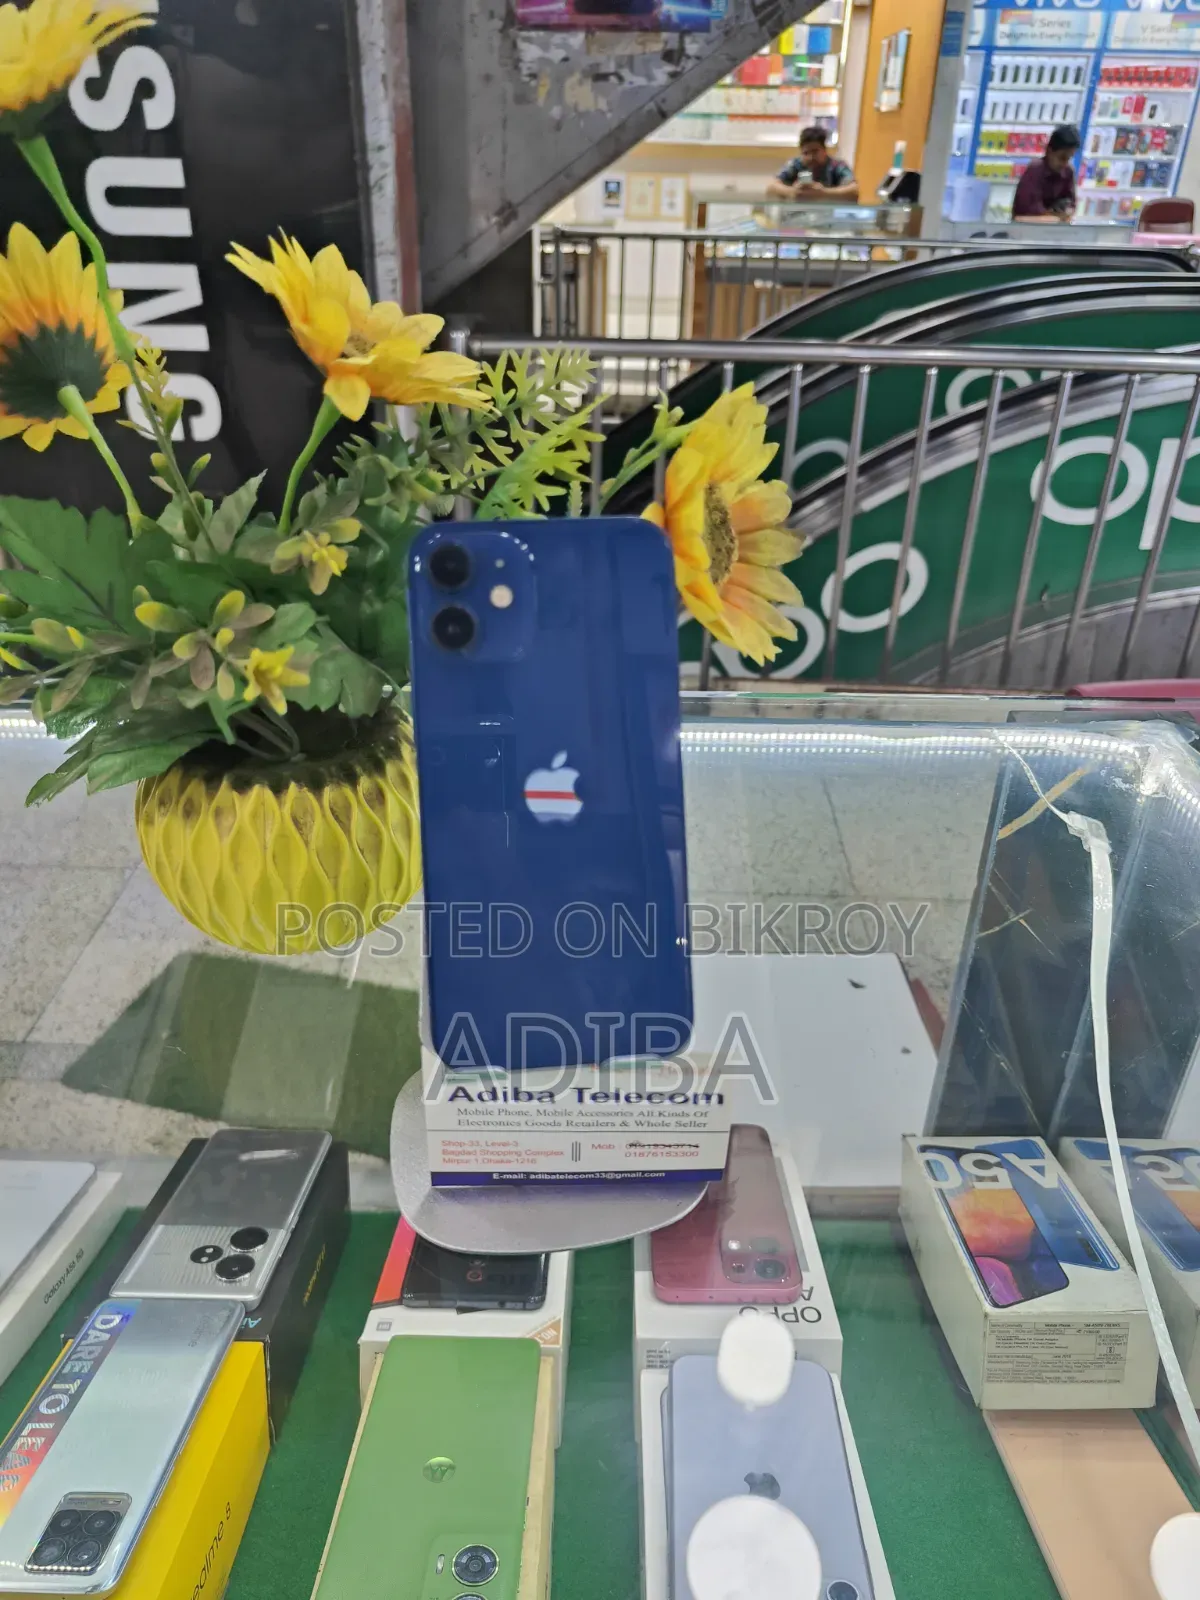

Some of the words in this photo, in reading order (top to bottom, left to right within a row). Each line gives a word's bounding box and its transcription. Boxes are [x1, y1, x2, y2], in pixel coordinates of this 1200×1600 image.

[1040, 17, 1072, 29] Series
[69, 0, 222, 442] SUNG
[448, 1086, 556, 1104] Adiba
[570, 1087, 724, 1106] Telecom
[456, 1107, 495, 1117] Mobile
[498, 1108, 533, 1118] Phone,
[536, 1108, 573, 1117] Mobile
[576, 1109, 634, 1118] Accessories
[636, 1110, 654, 1118] All
[658, 1110, 690, 1118] Kinds
[693, 1110, 709, 1118] Of
[457, 1119, 521, 1127] Electronics
[525, 1119, 562, 1127] Goods
[566, 1119, 616, 1128] Retailers
[619, 1120, 631, 1128] &
[634, 1120, 671, 1128] Whole
[674, 1120, 709, 1128] Seller
[480, 1148, 522, 1157] Shopping
[524, 1149, 565, 1157] Complex
[492, 1172, 527, 1180] E-mail:
[529, 1171, 666, 1181] adibatelecom33@gmail.com
[43, 1272, 66, 1305] Galaxy
[61, 1314, 124, 1374] DARE
[38, 1379, 83, 1415] TO
[190, 1520, 225, 1600] ealme
[225, 1501, 232, 1521] 8
